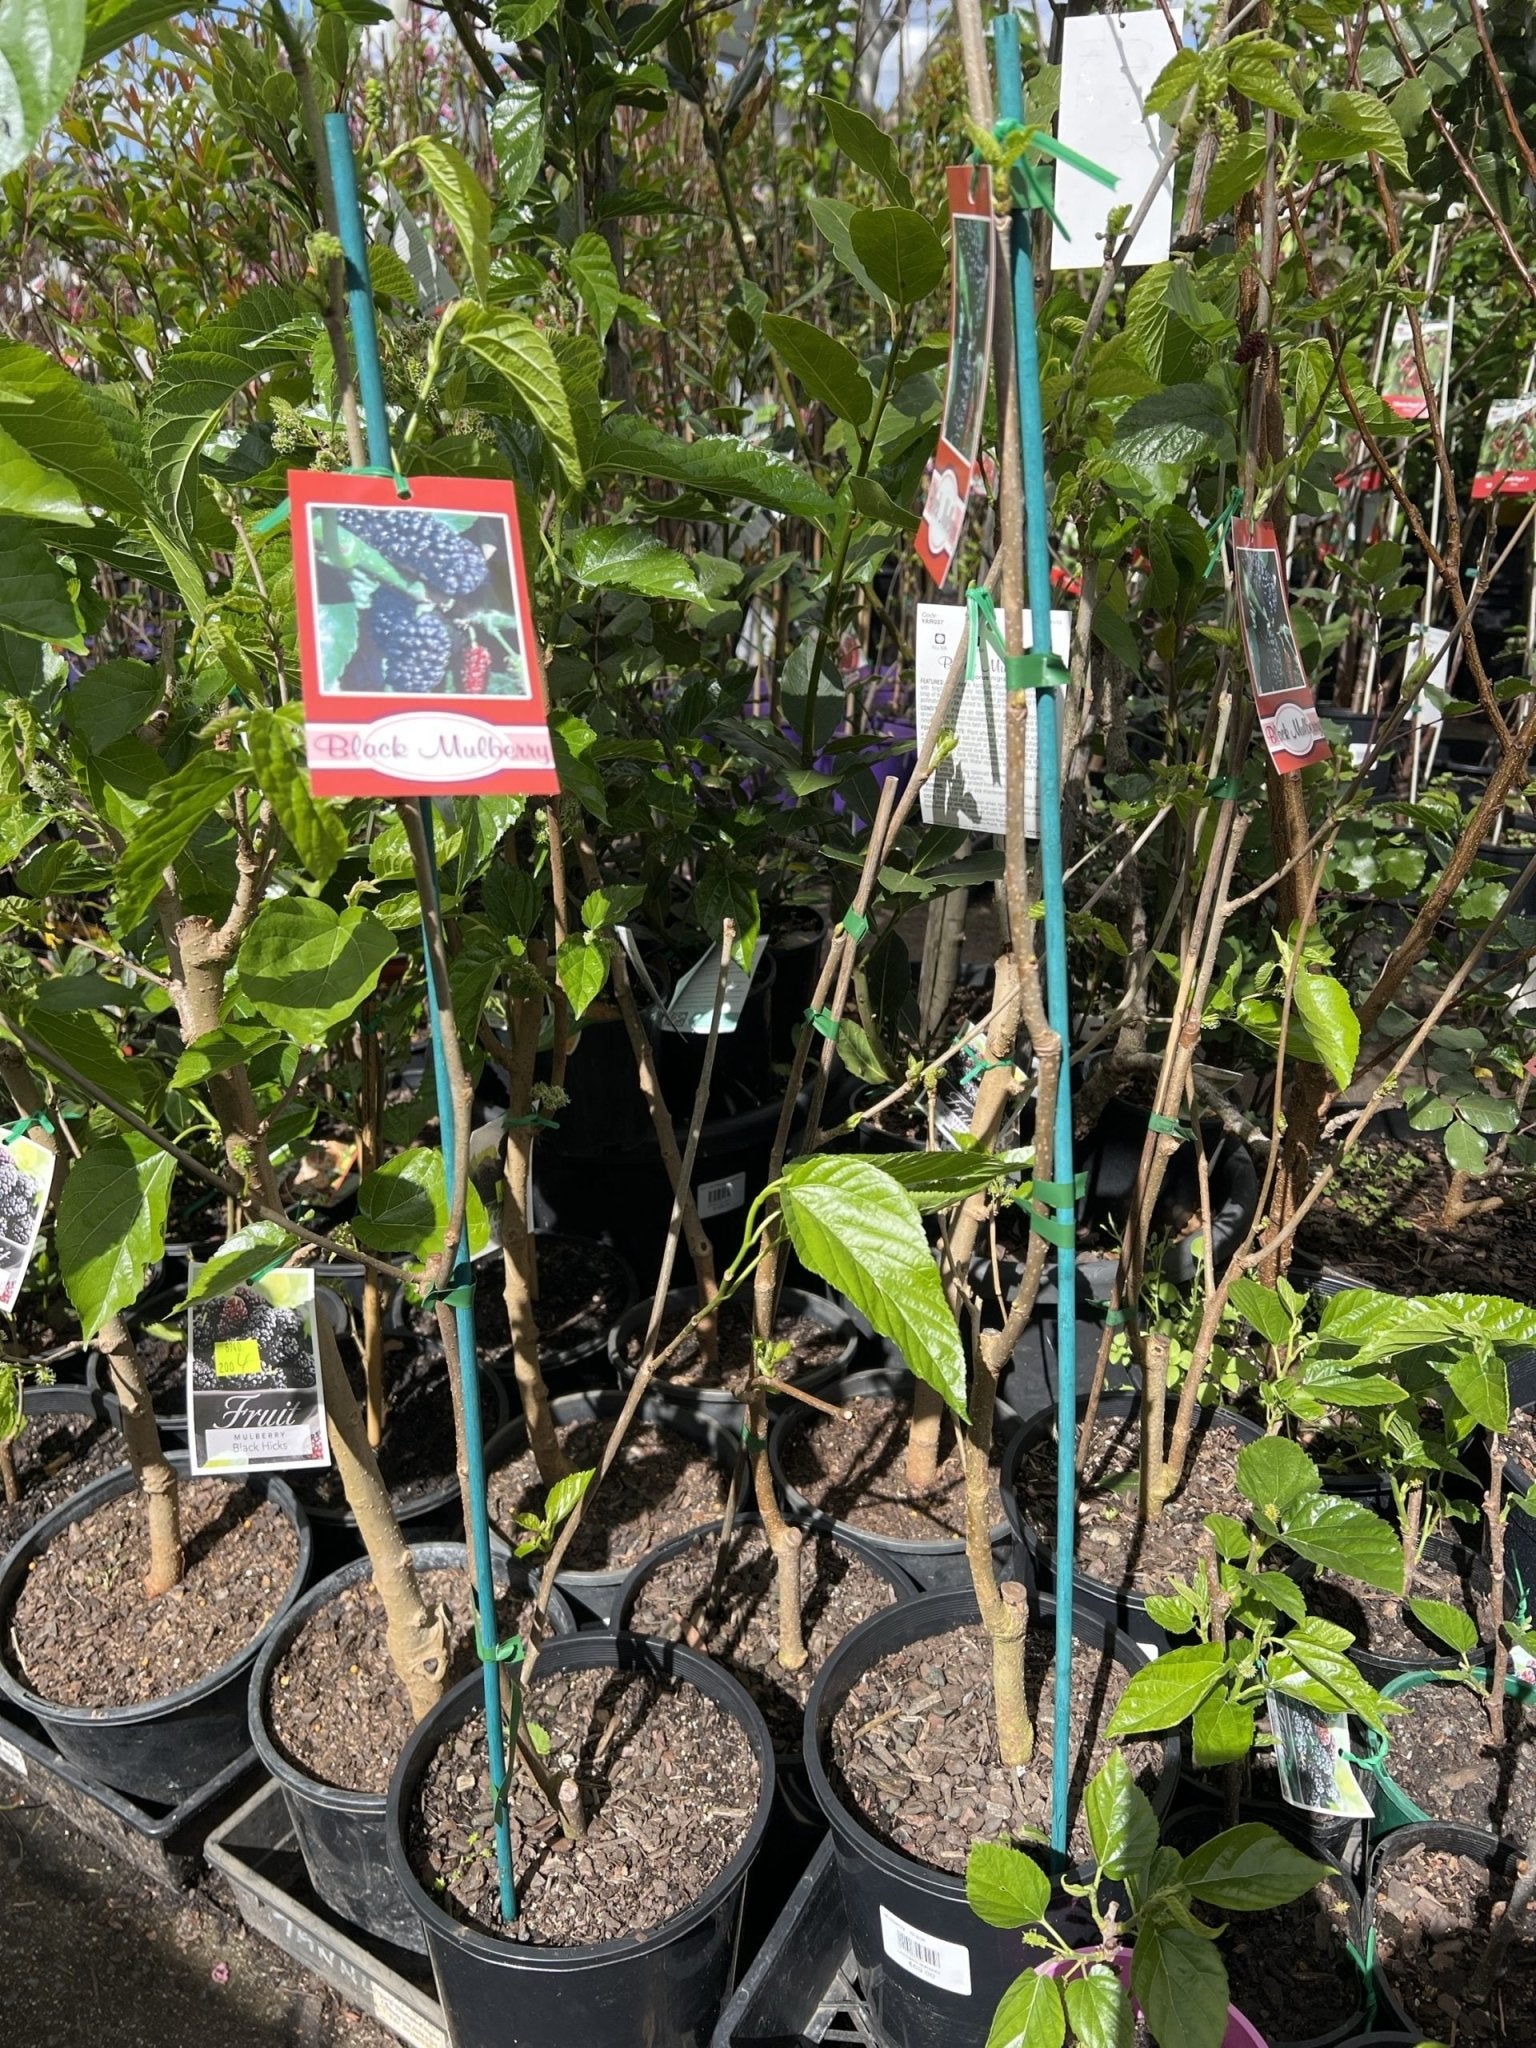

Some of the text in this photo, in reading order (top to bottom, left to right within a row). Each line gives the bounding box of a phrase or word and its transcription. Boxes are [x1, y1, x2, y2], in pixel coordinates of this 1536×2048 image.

[314, 734, 551, 765] Black Mulberry
[219, 1362, 235, 1373] 200
[213, 1393, 301, 1429] Fruit
[234, 1432, 286, 1441] MULBERRY
[232, 1440, 288, 1452] Black Hicks
